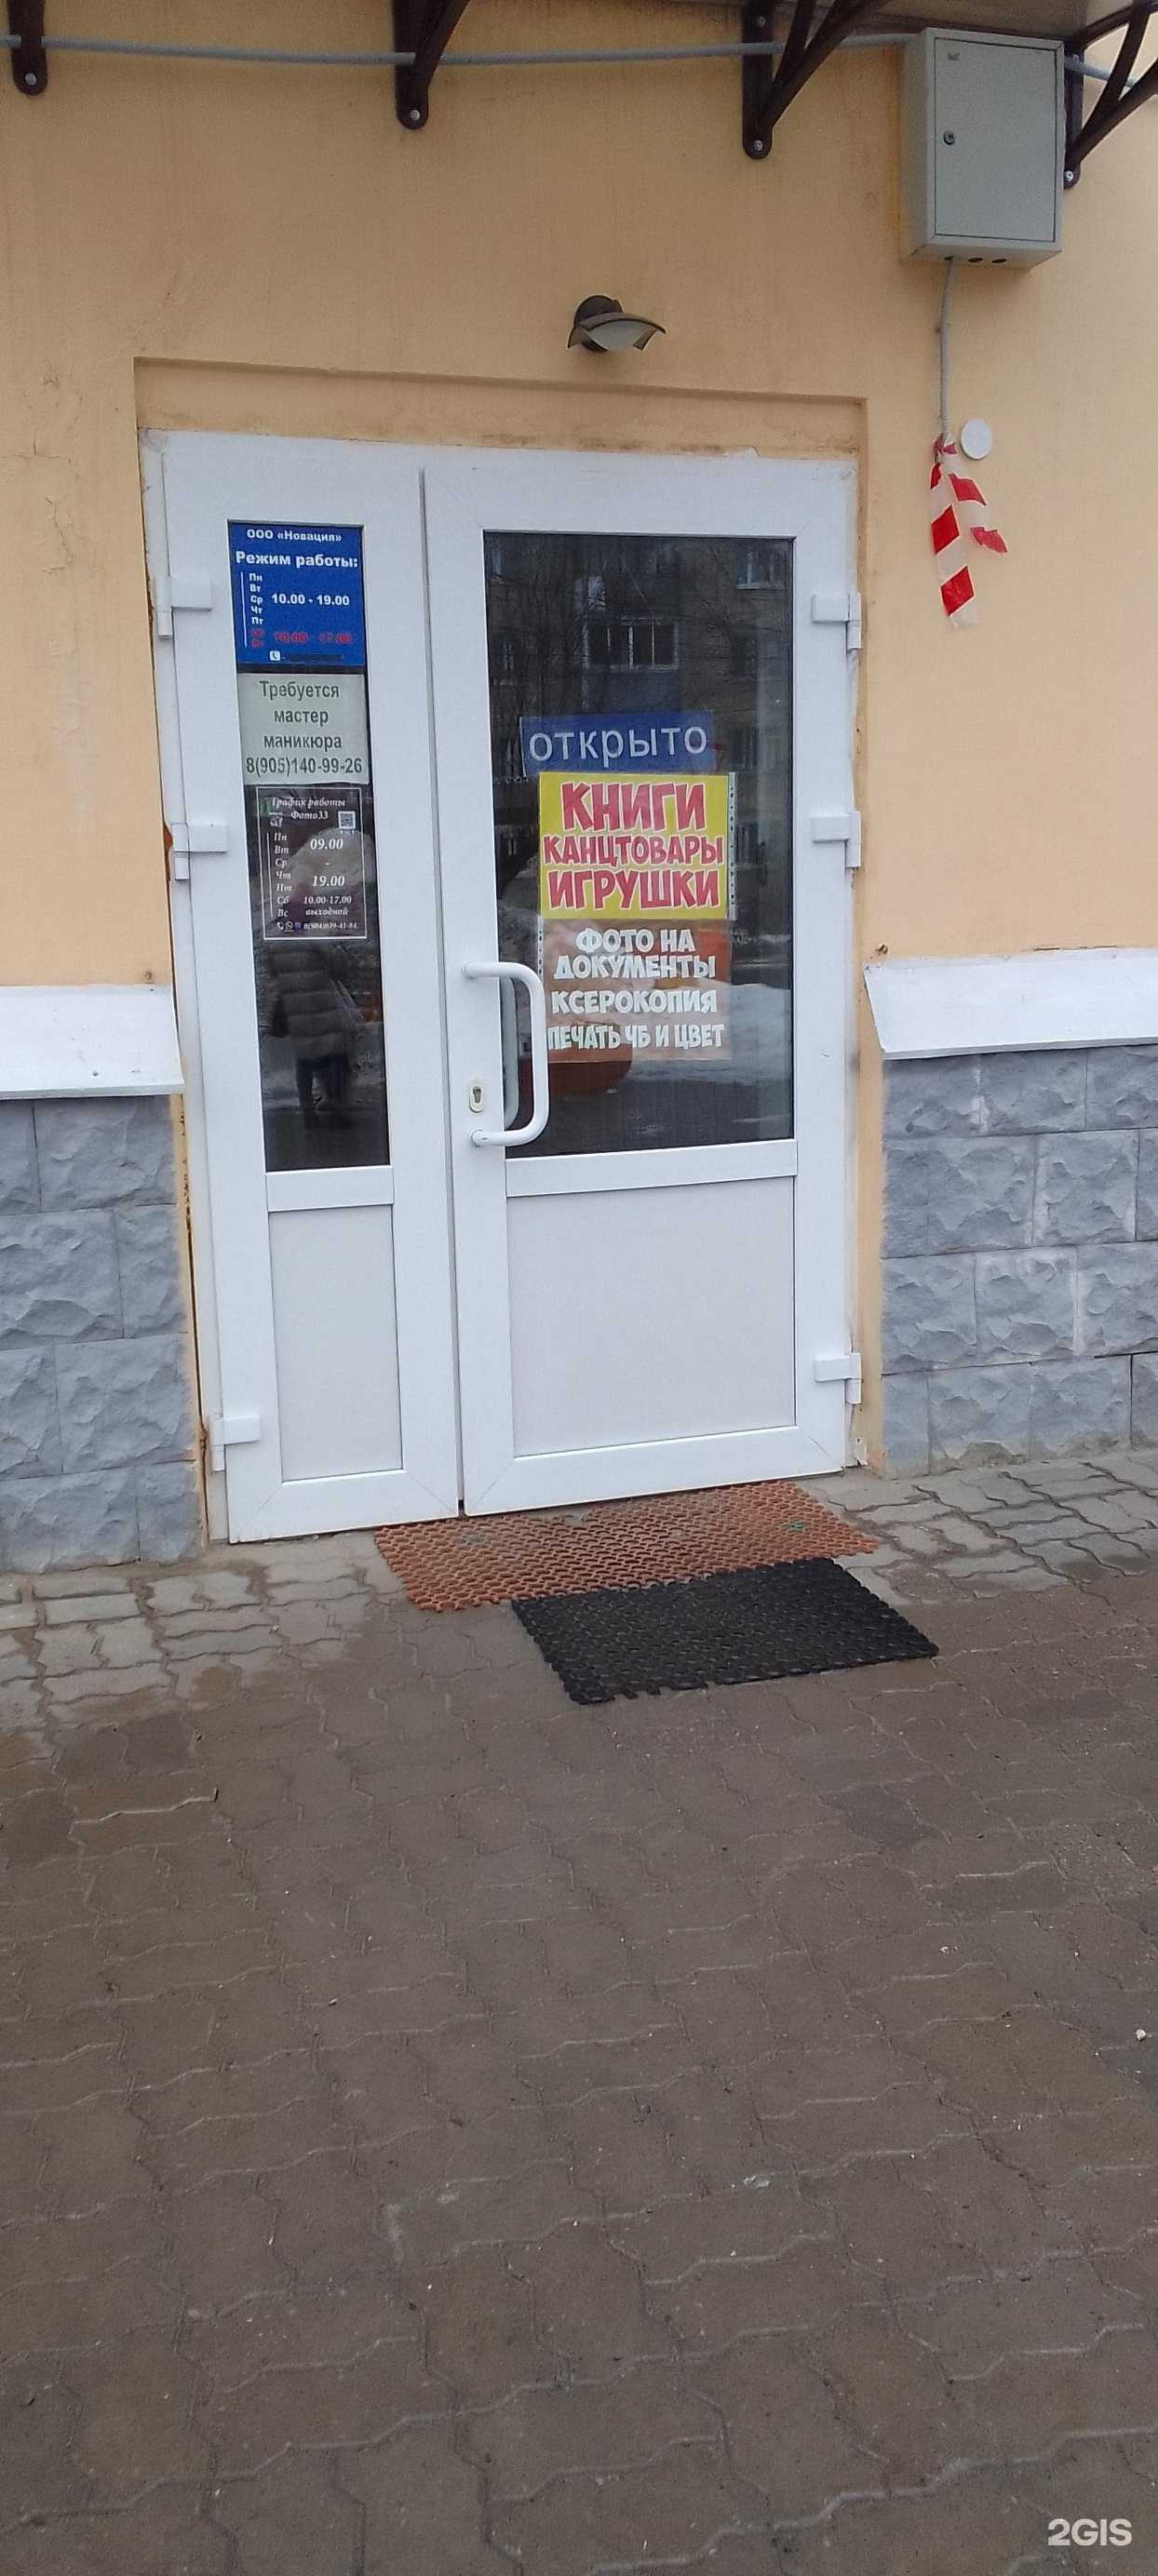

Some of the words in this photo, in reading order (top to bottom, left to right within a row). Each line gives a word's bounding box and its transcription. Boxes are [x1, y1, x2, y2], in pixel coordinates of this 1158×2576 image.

[247, 529, 274, 540] ООО
[277, 530, 343, 543] «Новация»
[236, 550, 291, 566] Режим
[296, 554, 358, 569] работы:
[249, 572, 263, 582] Пн
[249, 584, 262, 593] Вт
[250, 595, 263, 606] Ср
[272, 593, 305, 605] 10.00
[316, 595, 350, 606] 19.00
[250, 605, 263, 614] Чт
[251, 616, 263, 625] Пт
[259, 680, 340, 701] Требуется
[274, 709, 329, 727] мастер
[263, 734, 343, 752] маникюра
[246, 757, 363, 778] 8(905)140-99-26
[272, 797, 306, 809] График
[307, 797, 346, 810] работы
[560, 782, 707, 833] КНИГИ
[290, 810, 329, 820] Фото33
[274, 832, 288, 841] Пн
[274, 845, 290, 854] Вт
[310, 838, 343, 850] 09.00
[542, 834, 725, 867] КАНЦТОВАРЫ
[275, 857, 288, 869] Ср
[276, 870, 291, 879] Чт
[276, 882, 292, 892] Пт
[313, 875, 345, 887] 19.00
[546, 868, 721, 910] ИГРУШКИ
[276, 895, 290, 905] Сб
[277, 908, 290, 918] Вс
[304, 906, 349, 917] выходной
[575, 927, 654, 954] ФОТО
[660, 928, 696, 953] НА
[553, 954, 717, 980] ДОКУМЕНТЫ
[551, 988, 718, 1015] КСЕРОКОПИЯ
[546, 1024, 621, 1051] ПЕЧАТЬ
[625, 1024, 652, 1050] ЧБ
[654, 1024, 670, 1048] И
[673, 1024, 725, 1050] ЦВЕТ
